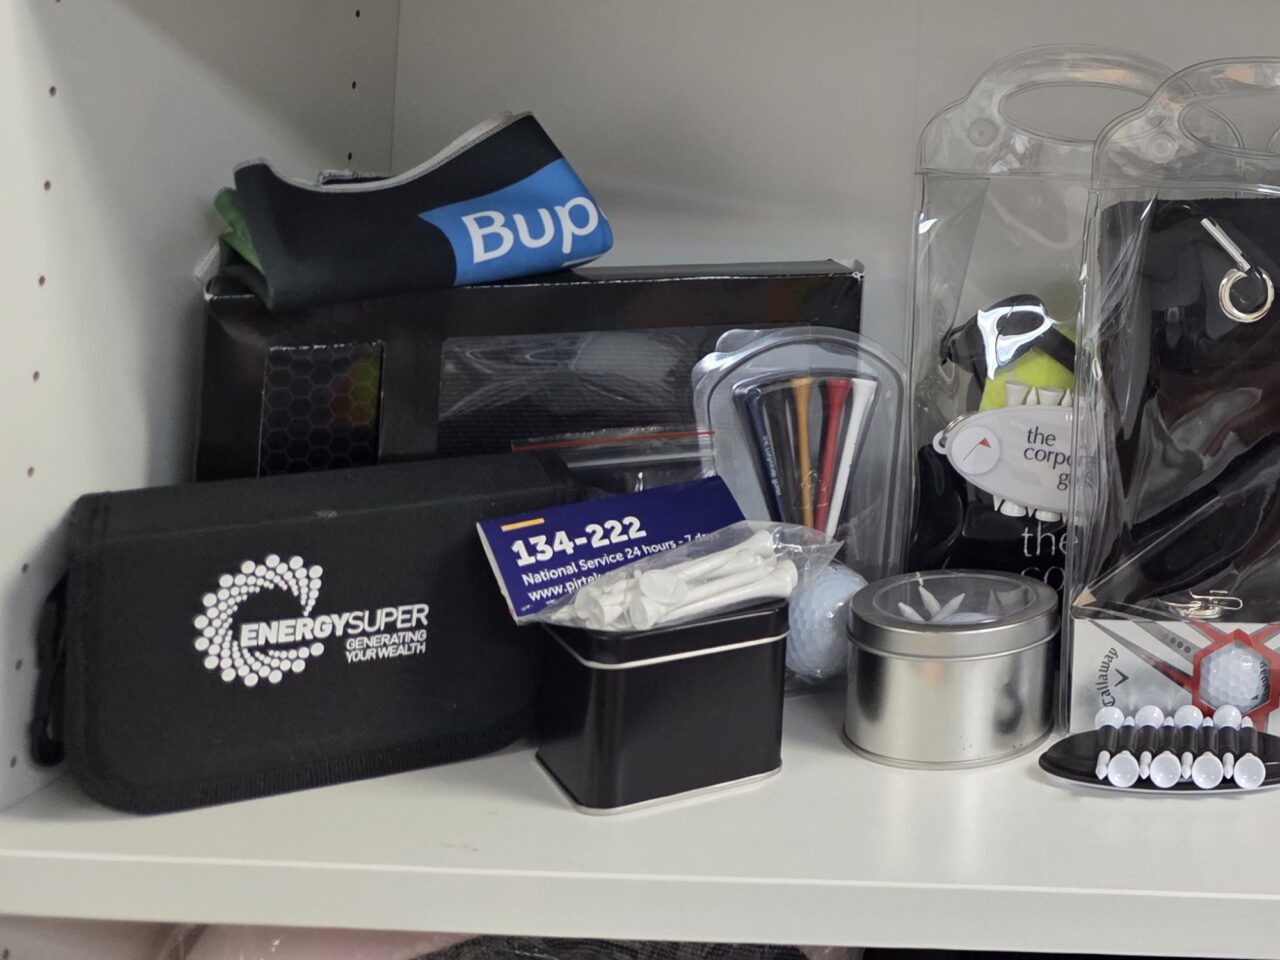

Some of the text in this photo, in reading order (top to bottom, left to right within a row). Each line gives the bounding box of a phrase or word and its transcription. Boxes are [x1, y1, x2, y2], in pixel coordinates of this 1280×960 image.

[461, 196, 607, 264] Bup
[1027, 426, 1057, 447] the
[511, 516, 647, 567] 134-222
[1021, 521, 1079, 557] the
[521, 559, 578, 587] National
[579, 552, 624, 571] Service
[625, 546, 642, 560] 24
[643, 539, 677, 556] hours
[240, 603, 430, 648] ENERGYSUPER
[346, 629, 428, 651] GENERATING
[345, 641, 427, 664] YOUR WEALTH
[1094, 646, 1120, 707] Callaway
